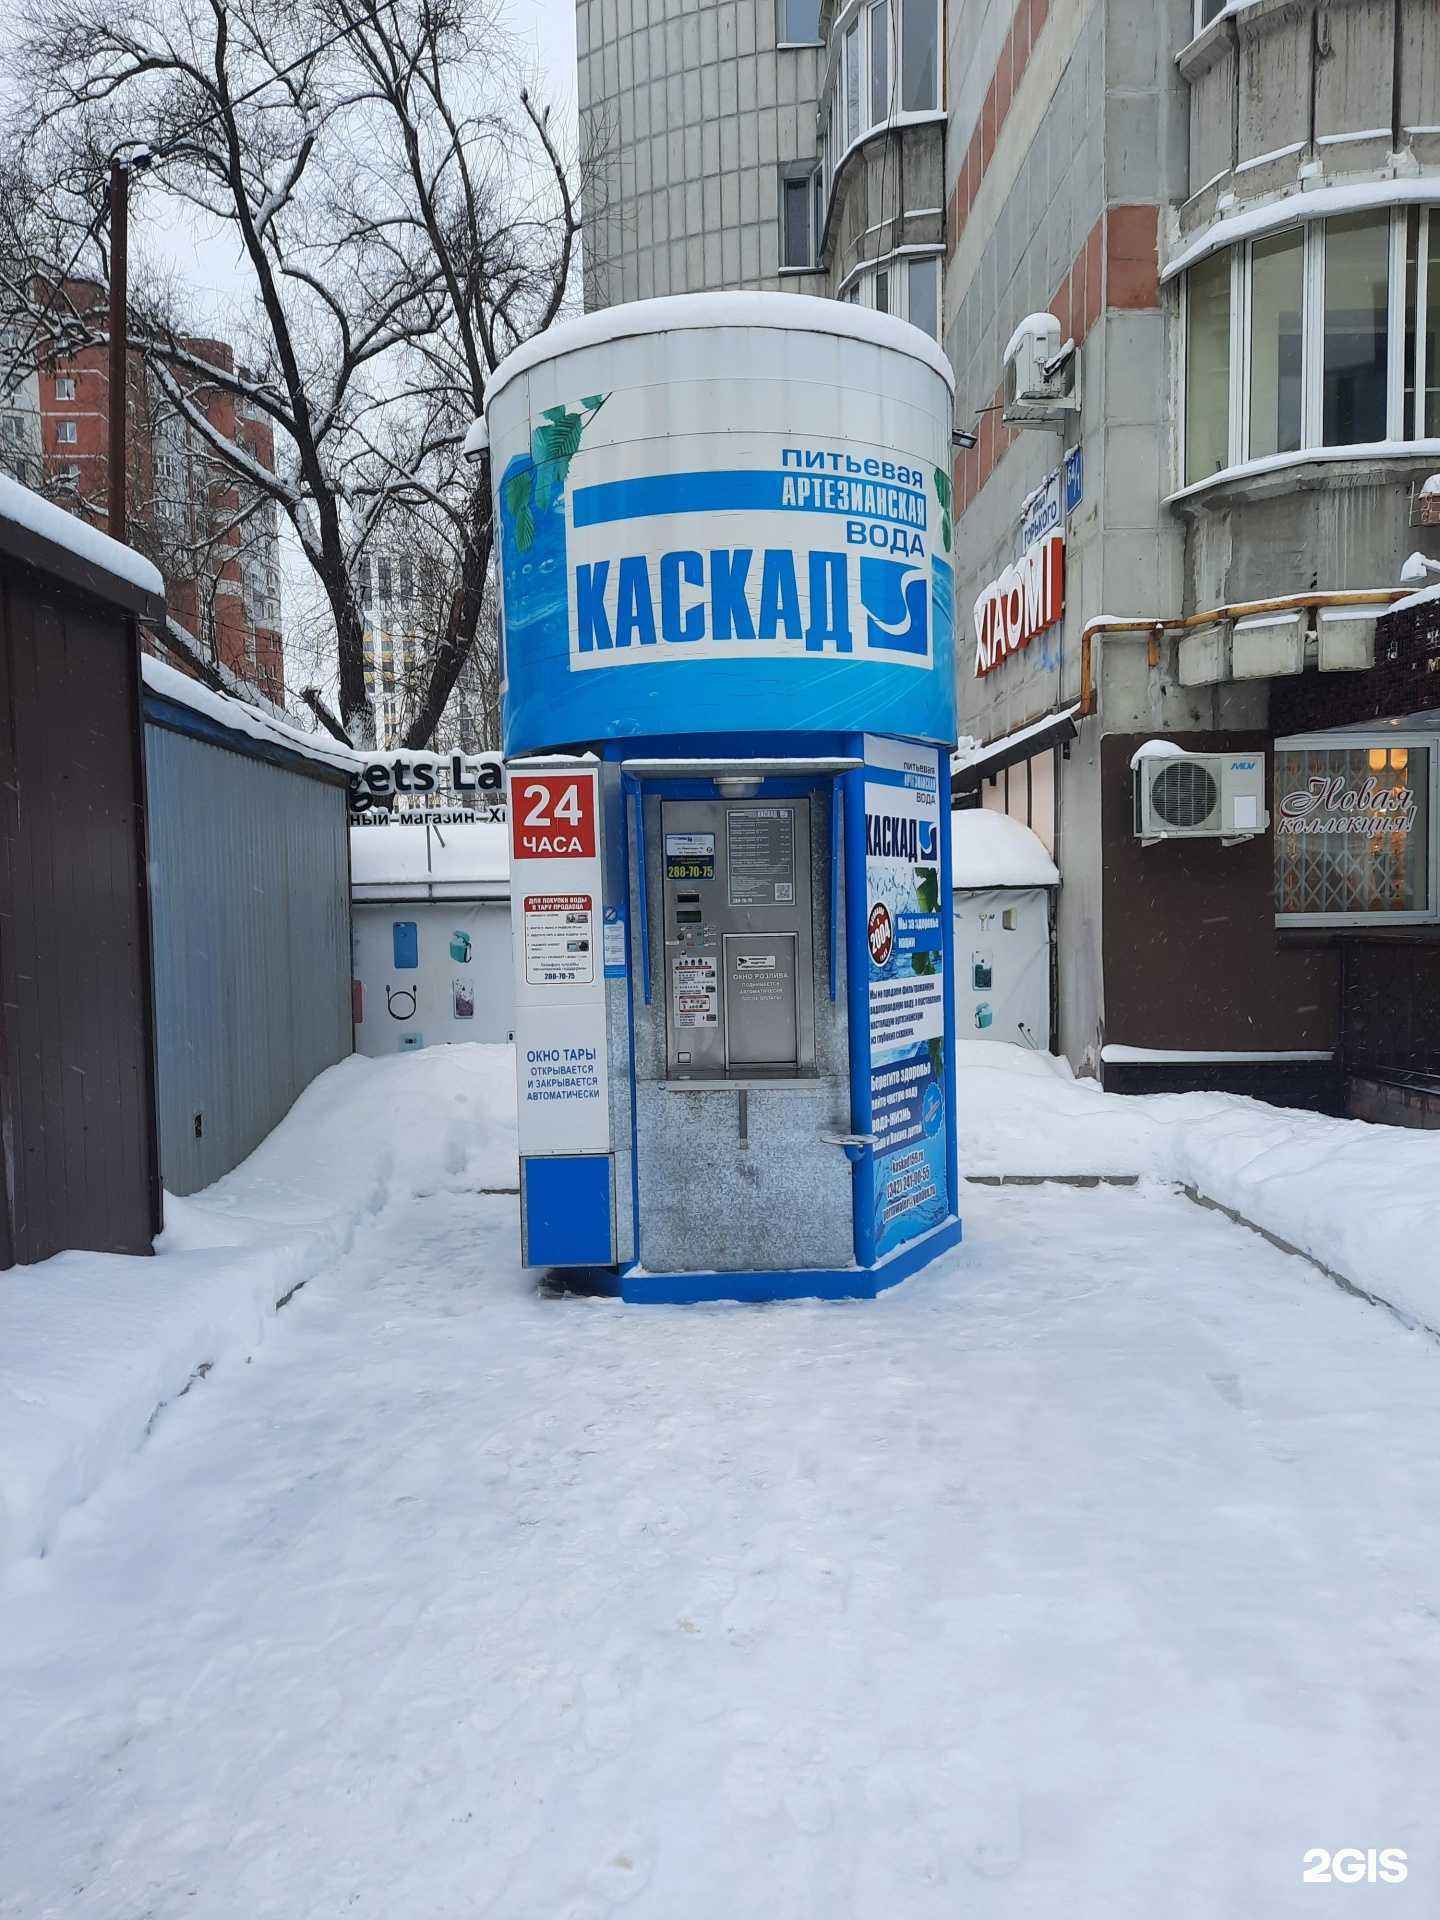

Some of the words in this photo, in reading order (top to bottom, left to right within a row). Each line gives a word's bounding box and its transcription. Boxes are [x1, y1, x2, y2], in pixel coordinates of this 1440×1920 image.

[782, 449, 923, 488] питьевая
[782, 476, 925, 527] АРТЕЗИАНСКАЯ
[846, 521, 925, 558] ВОДА
[1024, 501, 1057, 545] ГОРЬКОГО
[575, 549, 853, 654] КАСКАД
[974, 538, 1056, 678] XIAOMI
[452, 756, 503, 791] La
[904, 762, 935, 775] питьевая
[524, 784, 583, 826] 24
[916, 792, 936, 806] ВОДА
[1280, 776, 1415, 817] Новая
[400, 812, 475, 826] магазин
[1279, 806, 1417, 838] коллекция!
[523, 836, 583, 852] ЧАСА
[865, 814, 918, 863] КАСКАД
[870, 919, 891, 954] 2004
[527, 1050, 560, 1062] ОКНО
[563, 1048, 596, 1061] ТАРЫ
[531, 1065, 594, 1076] ОТКРЫВАЕТСЯ
[527, 1080, 533, 1089] И
[536, 1077, 598, 1088] ЗАКРЫВАЕТСЯ
[527, 1089, 600, 1101] АВТОМАТИЧЕСКИ
[871, 1070, 900, 1091] Берегите
